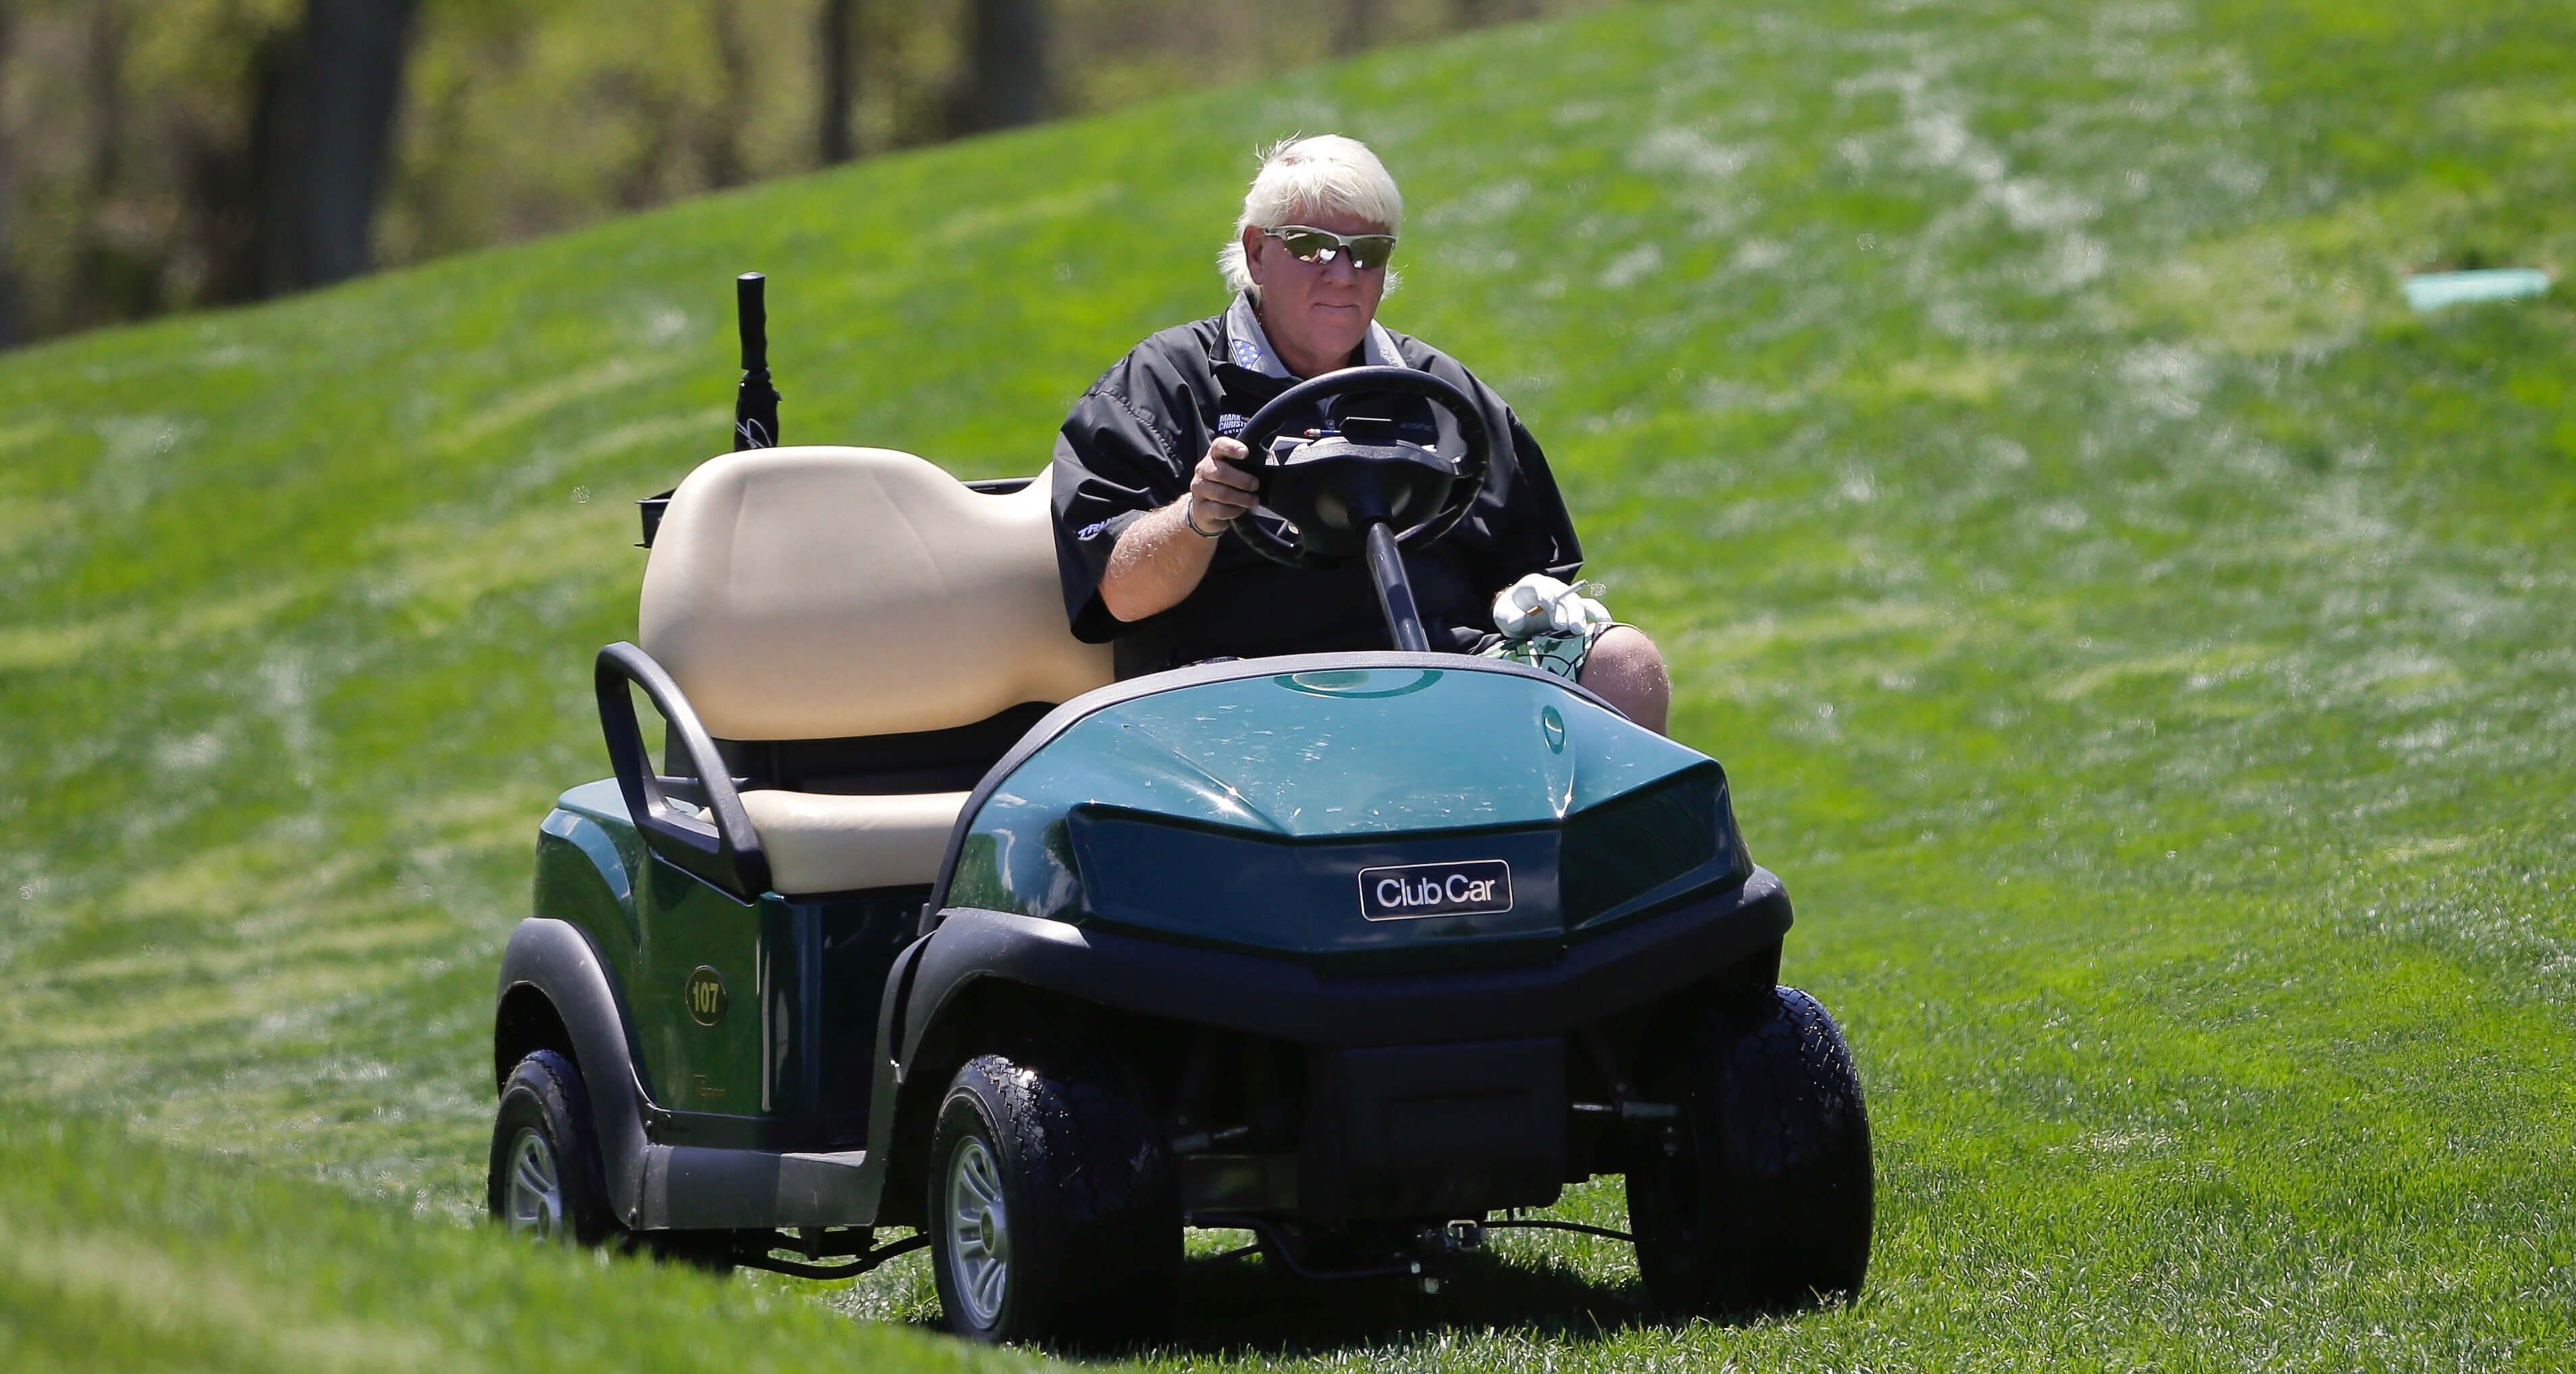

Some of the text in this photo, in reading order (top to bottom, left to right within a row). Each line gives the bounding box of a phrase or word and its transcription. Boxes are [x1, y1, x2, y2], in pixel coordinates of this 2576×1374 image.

[1219, 413, 1241, 422] MARK
[1078, 518, 1114, 538] TRU
[1376, 874, 1495, 908] Club Car
[692, 982, 719, 1013] 107
